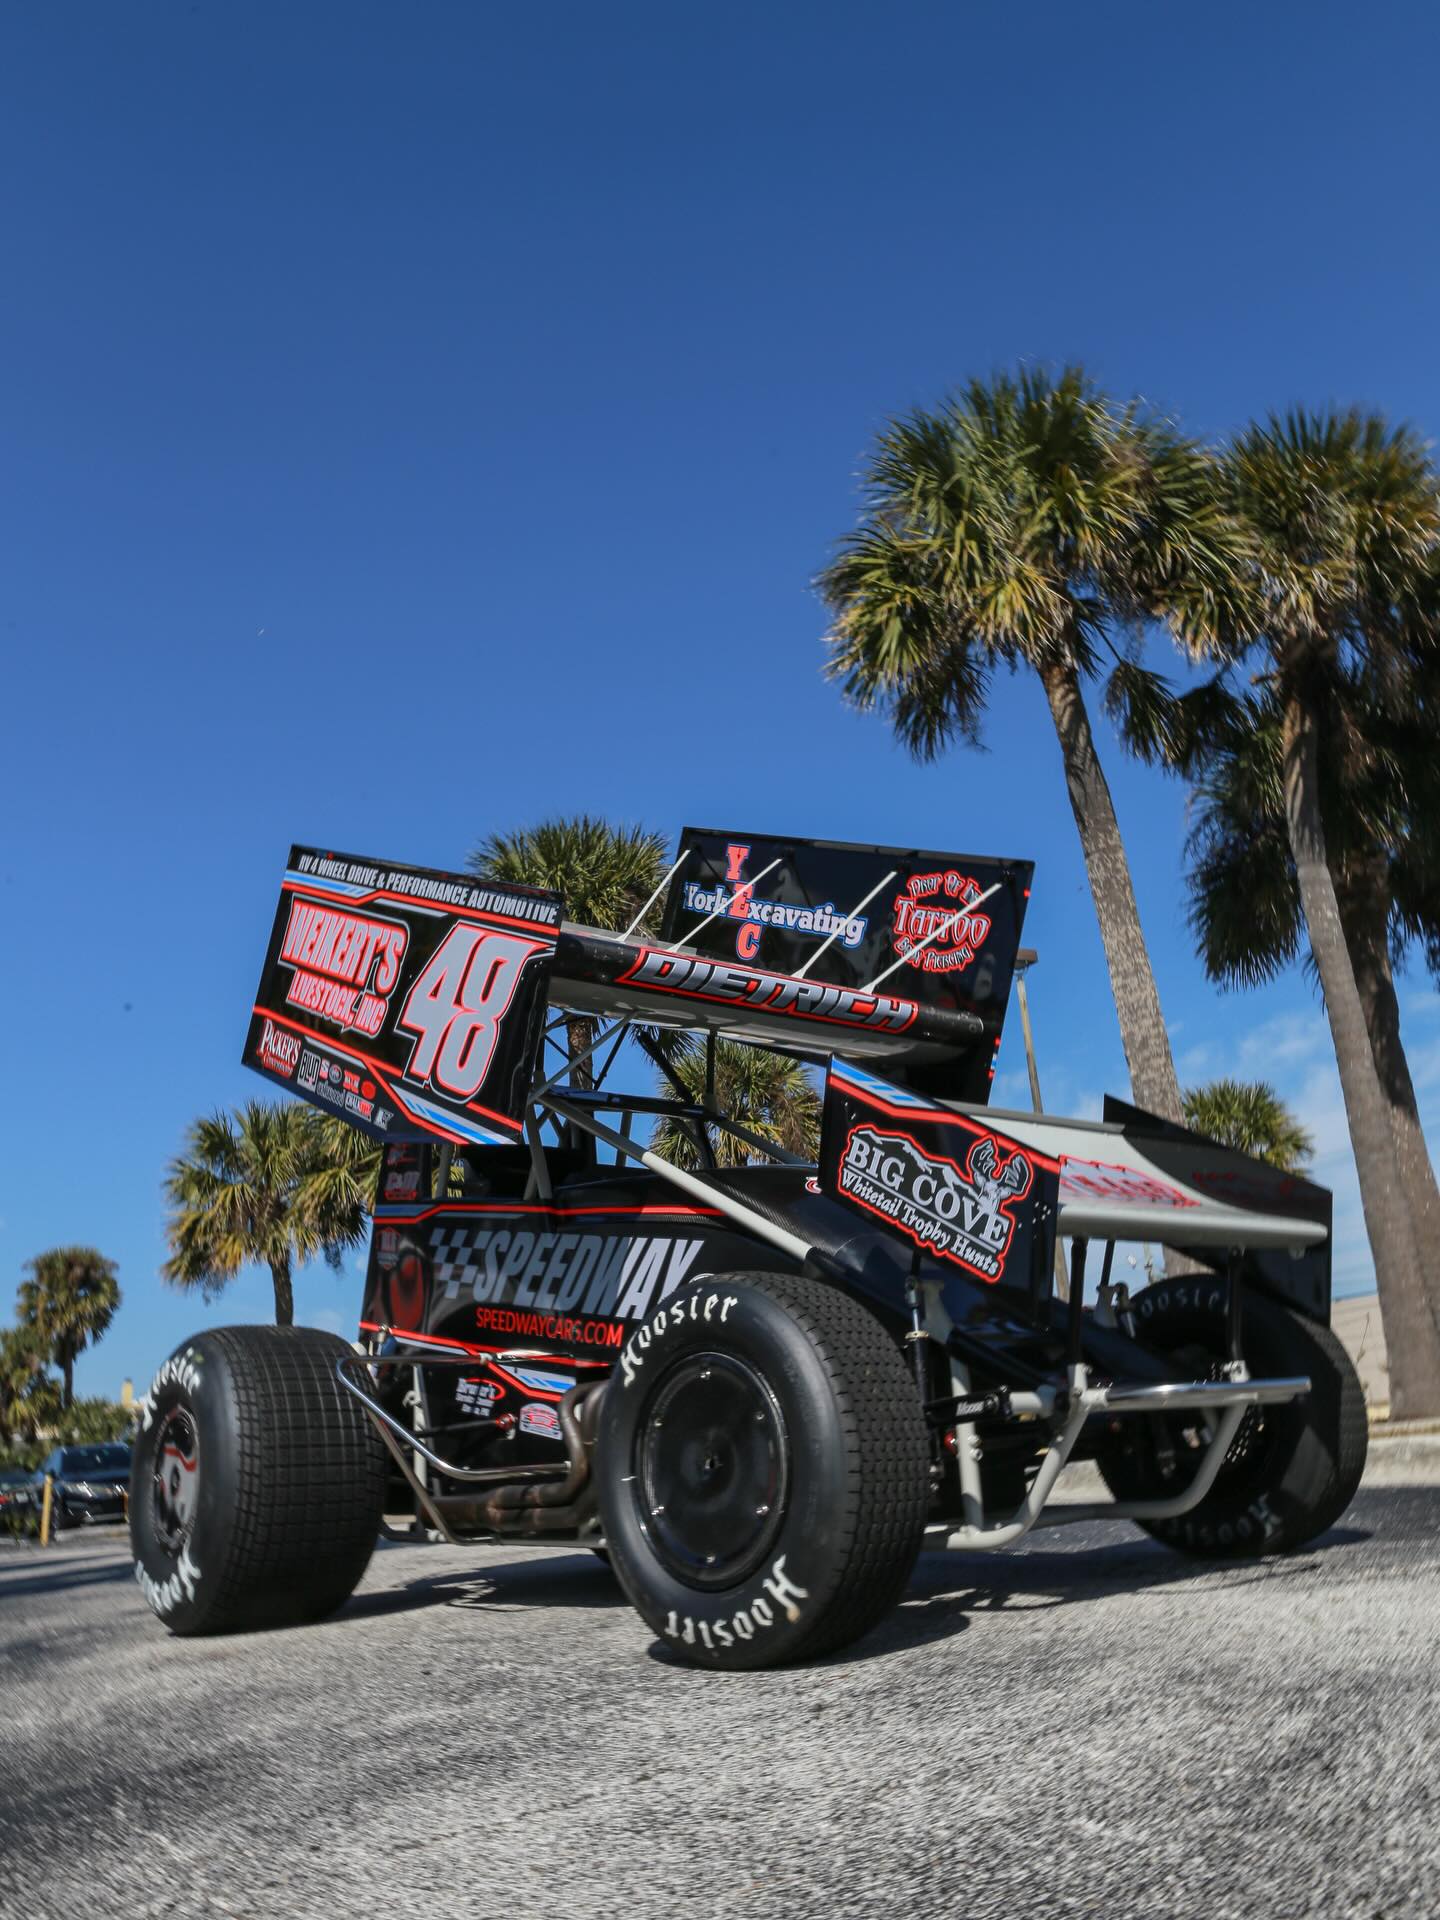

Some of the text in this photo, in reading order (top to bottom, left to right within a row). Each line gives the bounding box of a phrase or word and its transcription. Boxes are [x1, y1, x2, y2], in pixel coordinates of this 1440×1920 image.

[298, 855, 558, 924] RV 4 WHEEL DRIVE & PERFORMANCE AUTOMOTIVE
[283, 901, 407, 993] WEIKERT'S
[631, 952, 915, 1029] DIETRICH
[401, 922, 547, 1097] 48
[842, 1168, 999, 1276] Whitetail Trophy Hunts
[845, 1135, 906, 1191] BIG
[912, 1173, 1010, 1250] COVE
[473, 1230, 705, 1320] SPEEDWAY
[475, 1306, 624, 1347] SPEEDWAYCARS.COM
[621, 1288, 738, 1387] Hoosier
[665, 1553, 808, 1649] Hoosier
